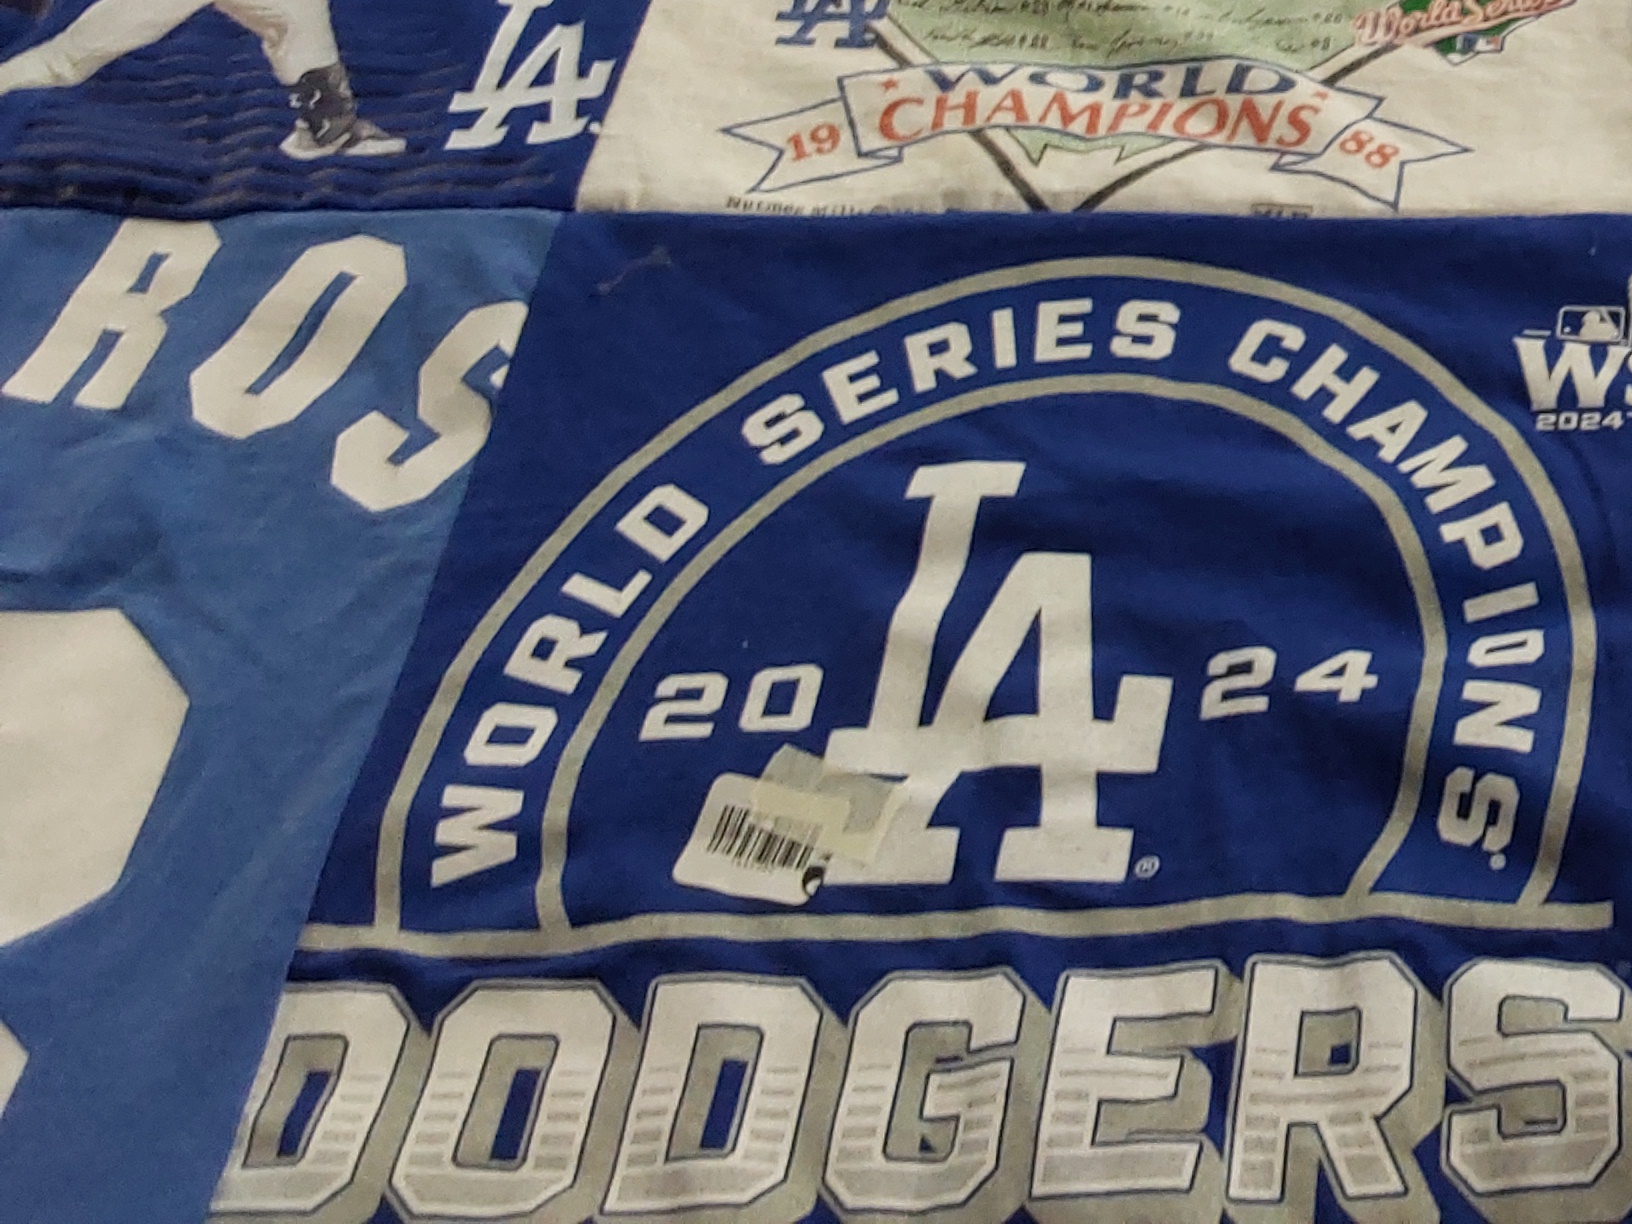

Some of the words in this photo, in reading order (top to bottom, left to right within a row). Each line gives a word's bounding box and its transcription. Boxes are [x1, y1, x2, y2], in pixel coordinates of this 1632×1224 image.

[925, 63, 1299, 101] WORLD
[784, 123, 842, 162] 19
[877, 87, 1322, 150] CHAMPIONS
[1338, 126, 1400, 170] 88
[1535, 409, 1626, 433] 2024
[431, 482, 711, 888] WORLD
[741, 296, 1183, 466] SERIES
[1227, 316, 1545, 856] CHAMPIONS
[638, 665, 824, 743] 20
[1199, 644, 1379, 720] 24
[814, 459, 1175, 886] LA
